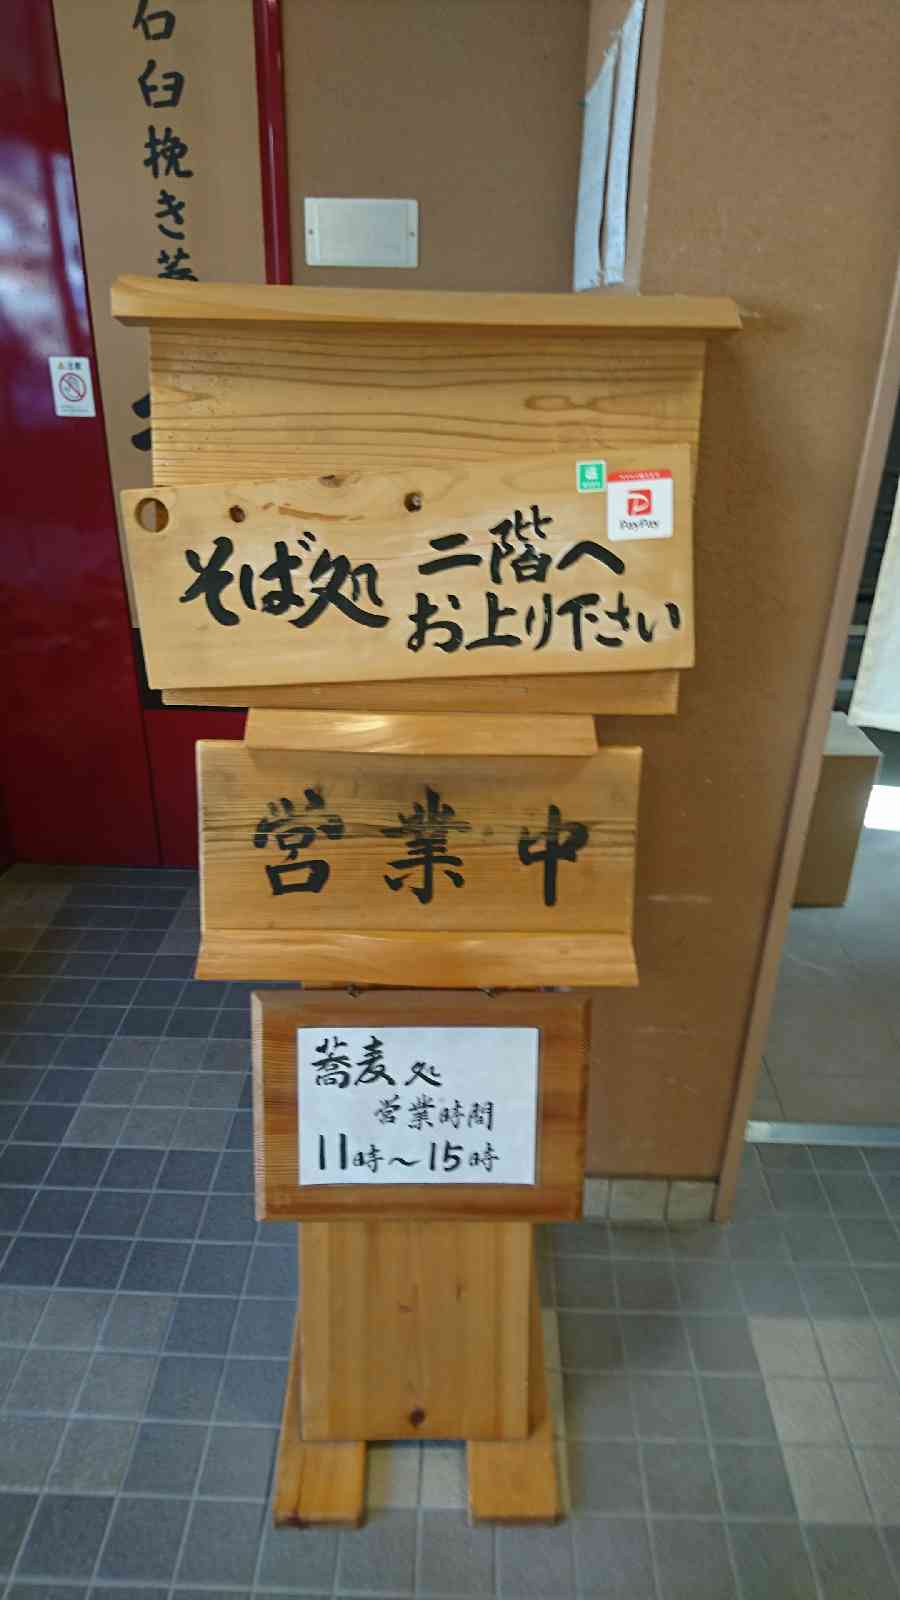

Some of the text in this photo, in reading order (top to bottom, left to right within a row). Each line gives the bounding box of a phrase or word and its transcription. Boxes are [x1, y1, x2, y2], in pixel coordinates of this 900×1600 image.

[179, 530, 391, 628] そば処
[417, 504, 625, 584] 二階へ
[407, 591, 681, 653] お上り下さい
[252, 785, 589, 907] 営業中
[311, 1035, 443, 1088] 蕎麦処
[374, 1094, 494, 1131] 営業時間
